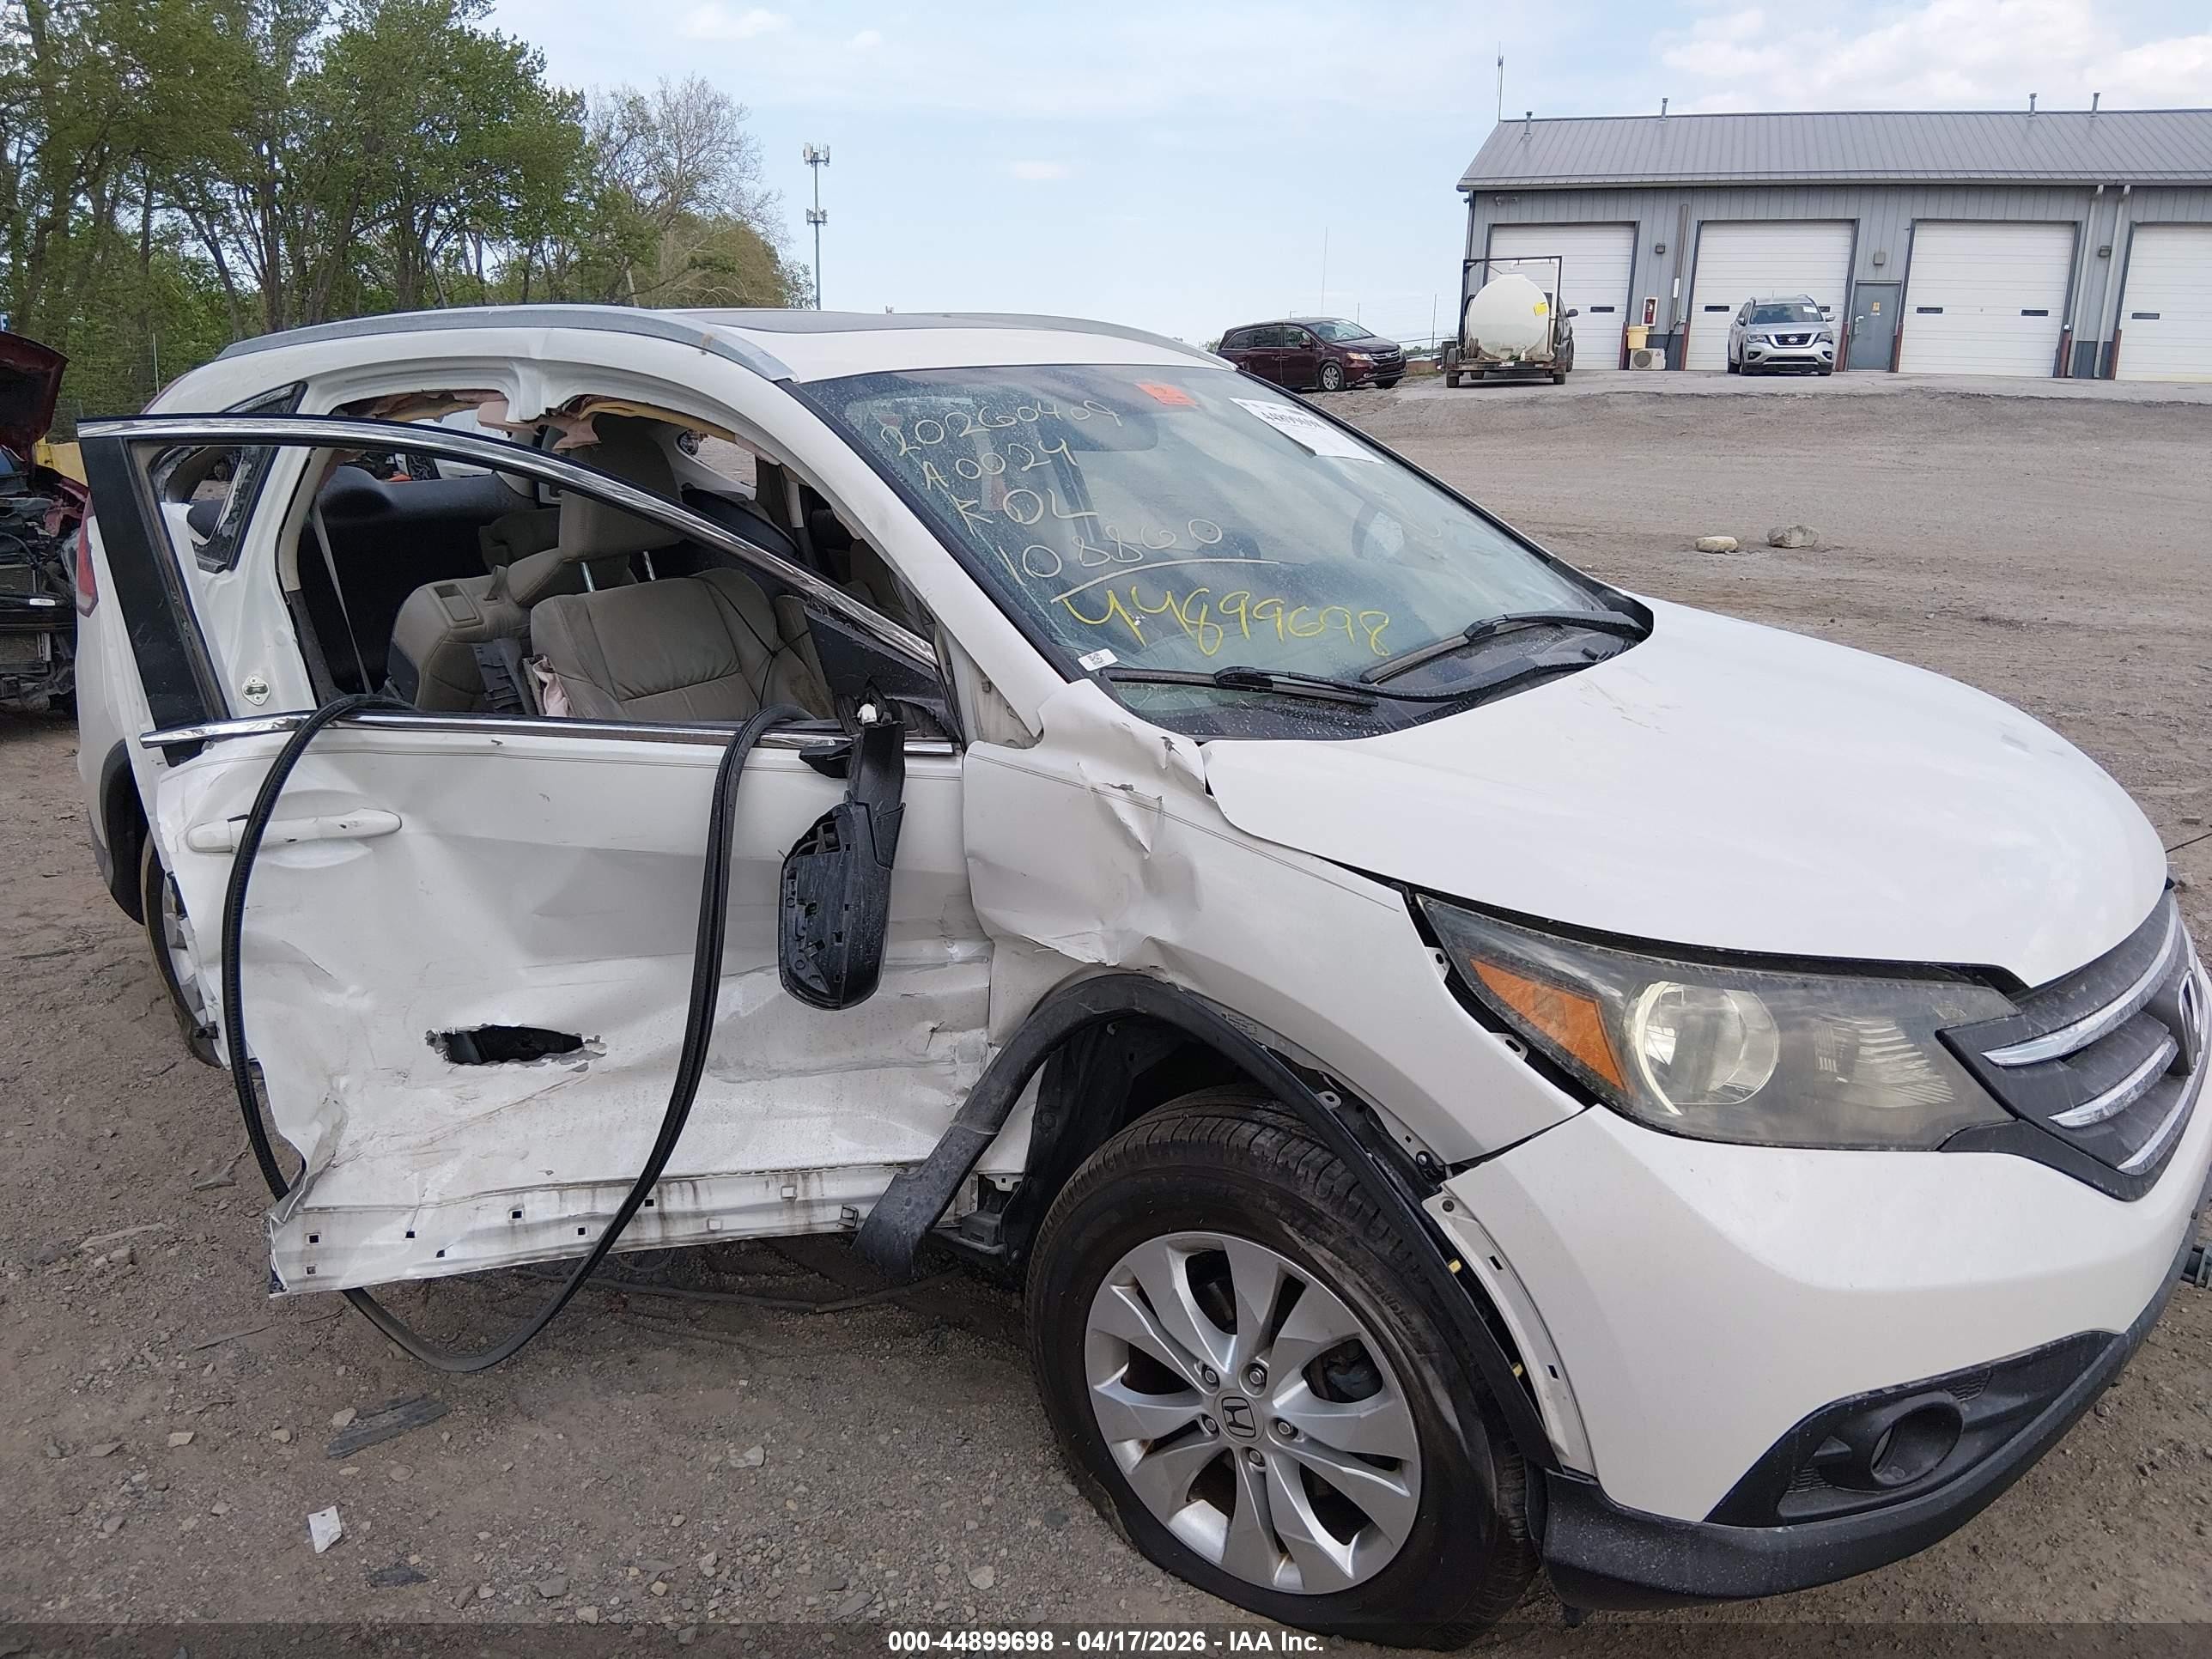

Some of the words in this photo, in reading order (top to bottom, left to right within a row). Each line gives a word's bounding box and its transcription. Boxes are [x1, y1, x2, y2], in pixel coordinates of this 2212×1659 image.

[880, 399, 1122, 456] 20260409
[922, 438, 1079, 490] A0024
[998, 515, 1223, 586] 108860
[1061, 586, 1392, 657] 44899698
